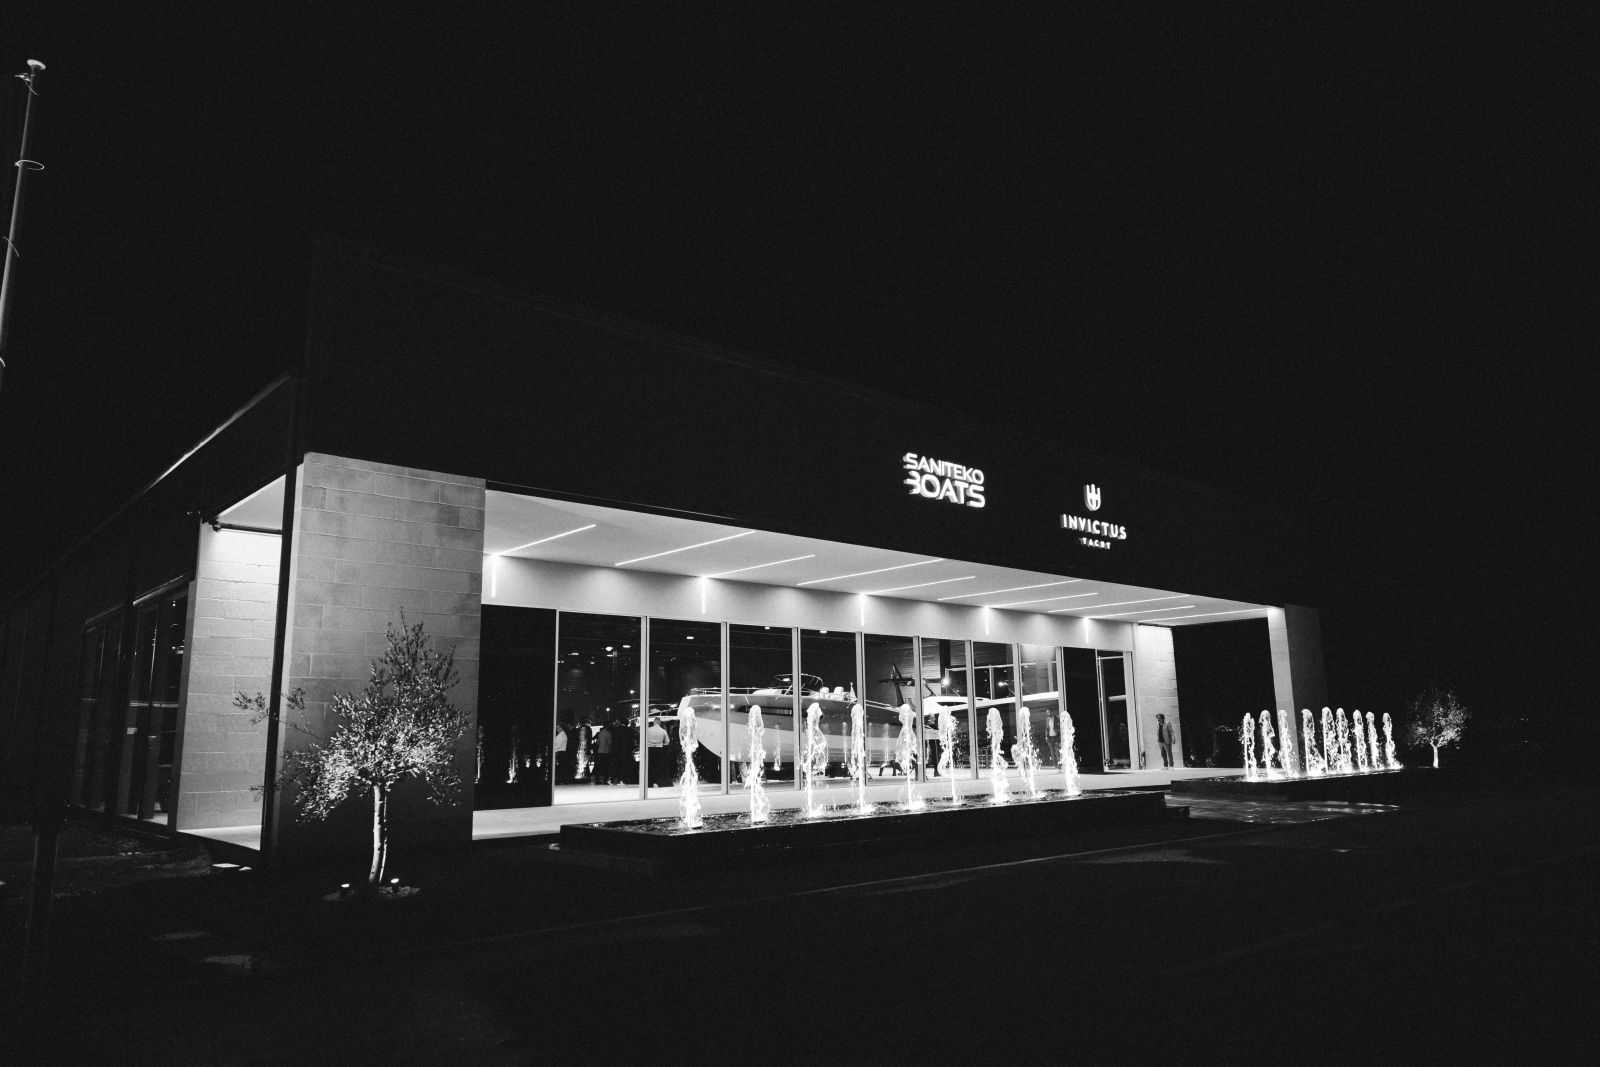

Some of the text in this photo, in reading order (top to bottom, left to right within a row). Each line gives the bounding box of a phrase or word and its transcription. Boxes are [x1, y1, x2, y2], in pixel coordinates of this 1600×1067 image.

[903, 452, 984, 485] SANITEKO
[904, 470, 985, 508] BOATS
[1060, 513, 1127, 540] INVICTUS
[1080, 537, 1111, 550] YACHT
